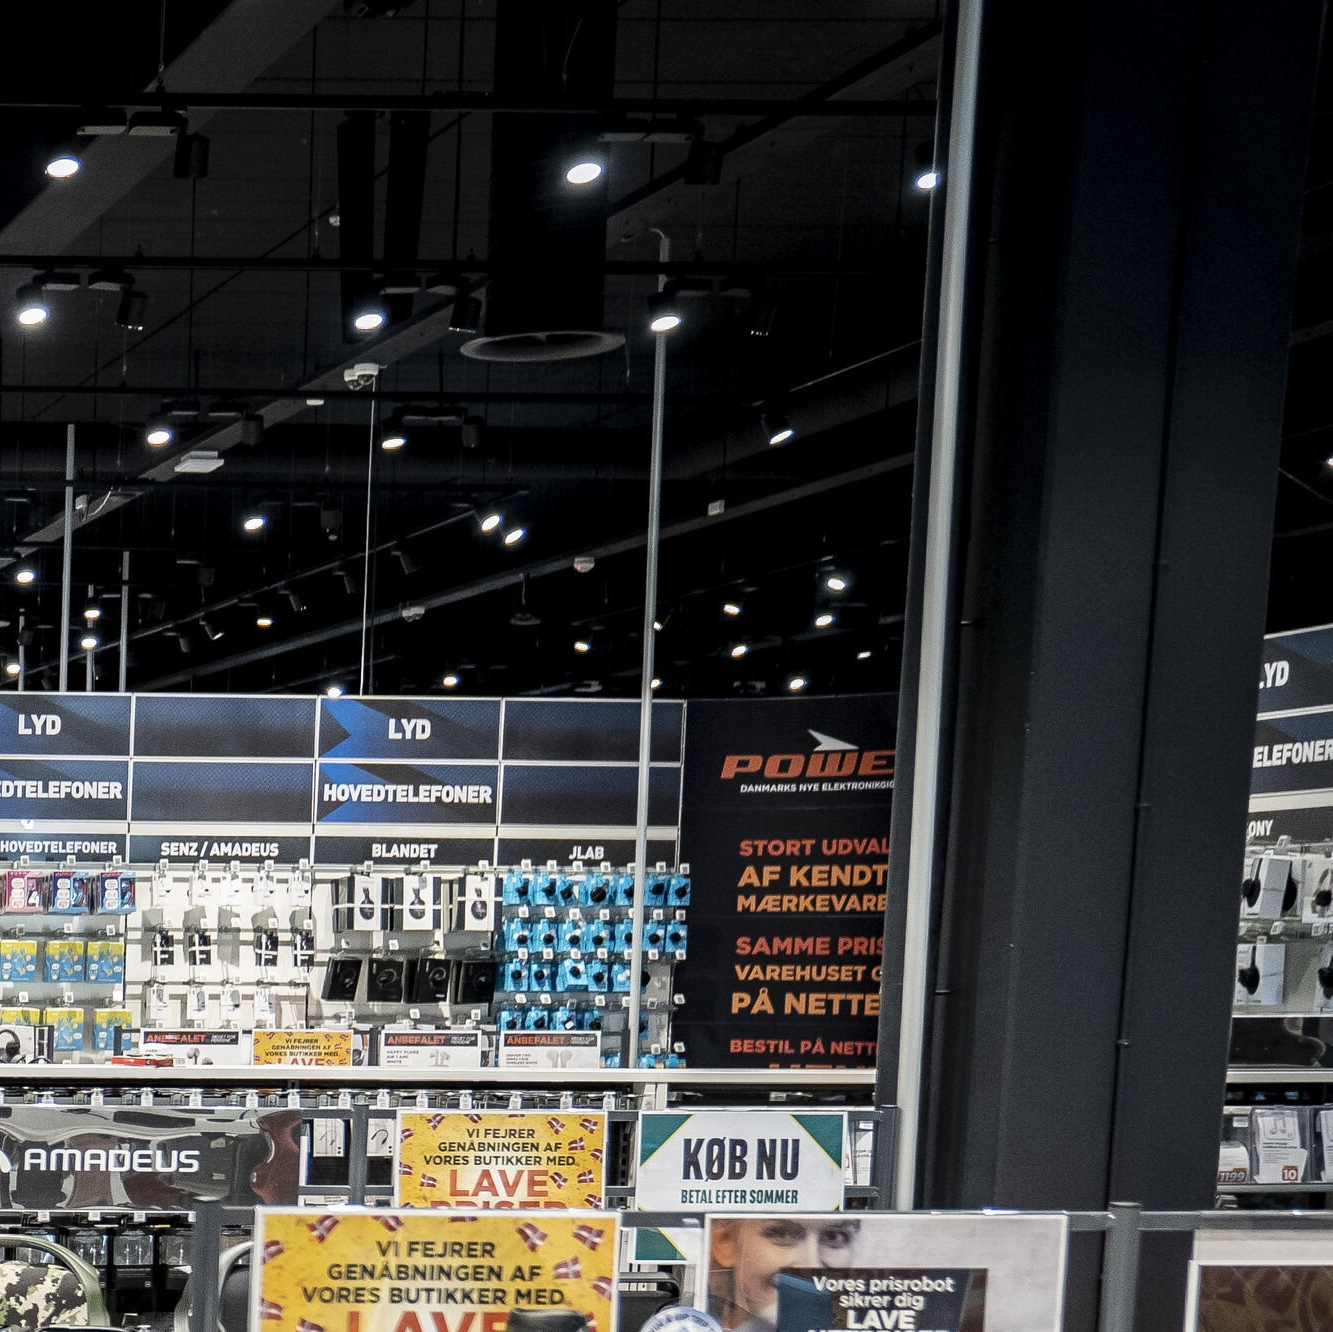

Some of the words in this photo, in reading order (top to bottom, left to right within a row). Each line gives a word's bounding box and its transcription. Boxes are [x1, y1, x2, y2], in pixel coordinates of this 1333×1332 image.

[18, 713, 62, 736] LYD
[388, 717, 431, 741] LYD
[323, 784, 493, 805] HOVEDTELEFONER
[739, 783, 798, 793] DANMARKS
[799, 782, 819, 792] NYE
[0, 839, 118, 855] HOVEDTELEFONER
[160, 841, 197, 857] SENZ
[199, 841, 208, 858] /
[210, 841, 279, 857] AMADEUS
[371, 843, 438, 859] BLANDET
[569, 845, 605, 861] JLAB
[739, 838, 816, 857] STORT
[737, 864, 781, 888] AF
[789, 864, 889, 887] KENDT
[735, 936, 831, 956] SAMME
[734, 964, 866, 982] VAREHUSET
[731, 986, 775, 1015] PÅ
[784, 992, 881, 1016] NETTE
[387, 1035, 445, 1045] ANBEFALET
[506, 1035, 565, 1045] ANBEFALET
[729, 1038, 795, 1054] BESTIL
[800, 1037, 825, 1055] PÅ
[466, 1128, 480, 1139] VI
[482, 1128, 536, 1140] FEJRER
[438, 1138, 540, 1153] GENÅBNINGEN
[543, 1141, 562, 1153] AF
[24, 1148, 200, 1174] AMADEUS
[424, 1155, 470, 1167] VORES
[473, 1155, 542, 1167] BUTIKKER
[546, 1155, 576, 1167] MED
[682, 1134, 748, 1184] KØB
[754, 1137, 800, 1181] NU
[449, 1169, 550, 1198] LAVE
[680, 1189, 713, 1205] BETAL
[715, 1189, 745, 1204] EFTER
[748, 1189, 799, 1205] SOMMER
[376, 1241, 398, 1258] VI
[405, 1240, 495, 1260] FEJRER
[326, 1260, 505, 1283] GENÅBNINGEN
[511, 1263, 542, 1281] AF
[813, 1276, 865, 1293] Vores
[868, 1275, 956, 1295] prisrobot
[302, 1286, 380, 1305] VORES
[386, 1286, 508, 1306] BUTIKKER
[513, 1287, 565, 1306] MED
[839, 1292, 891, 1309] sikrer
[893, 1292, 925, 1312] dig
[846, 1310, 917, 1331] LAVE
